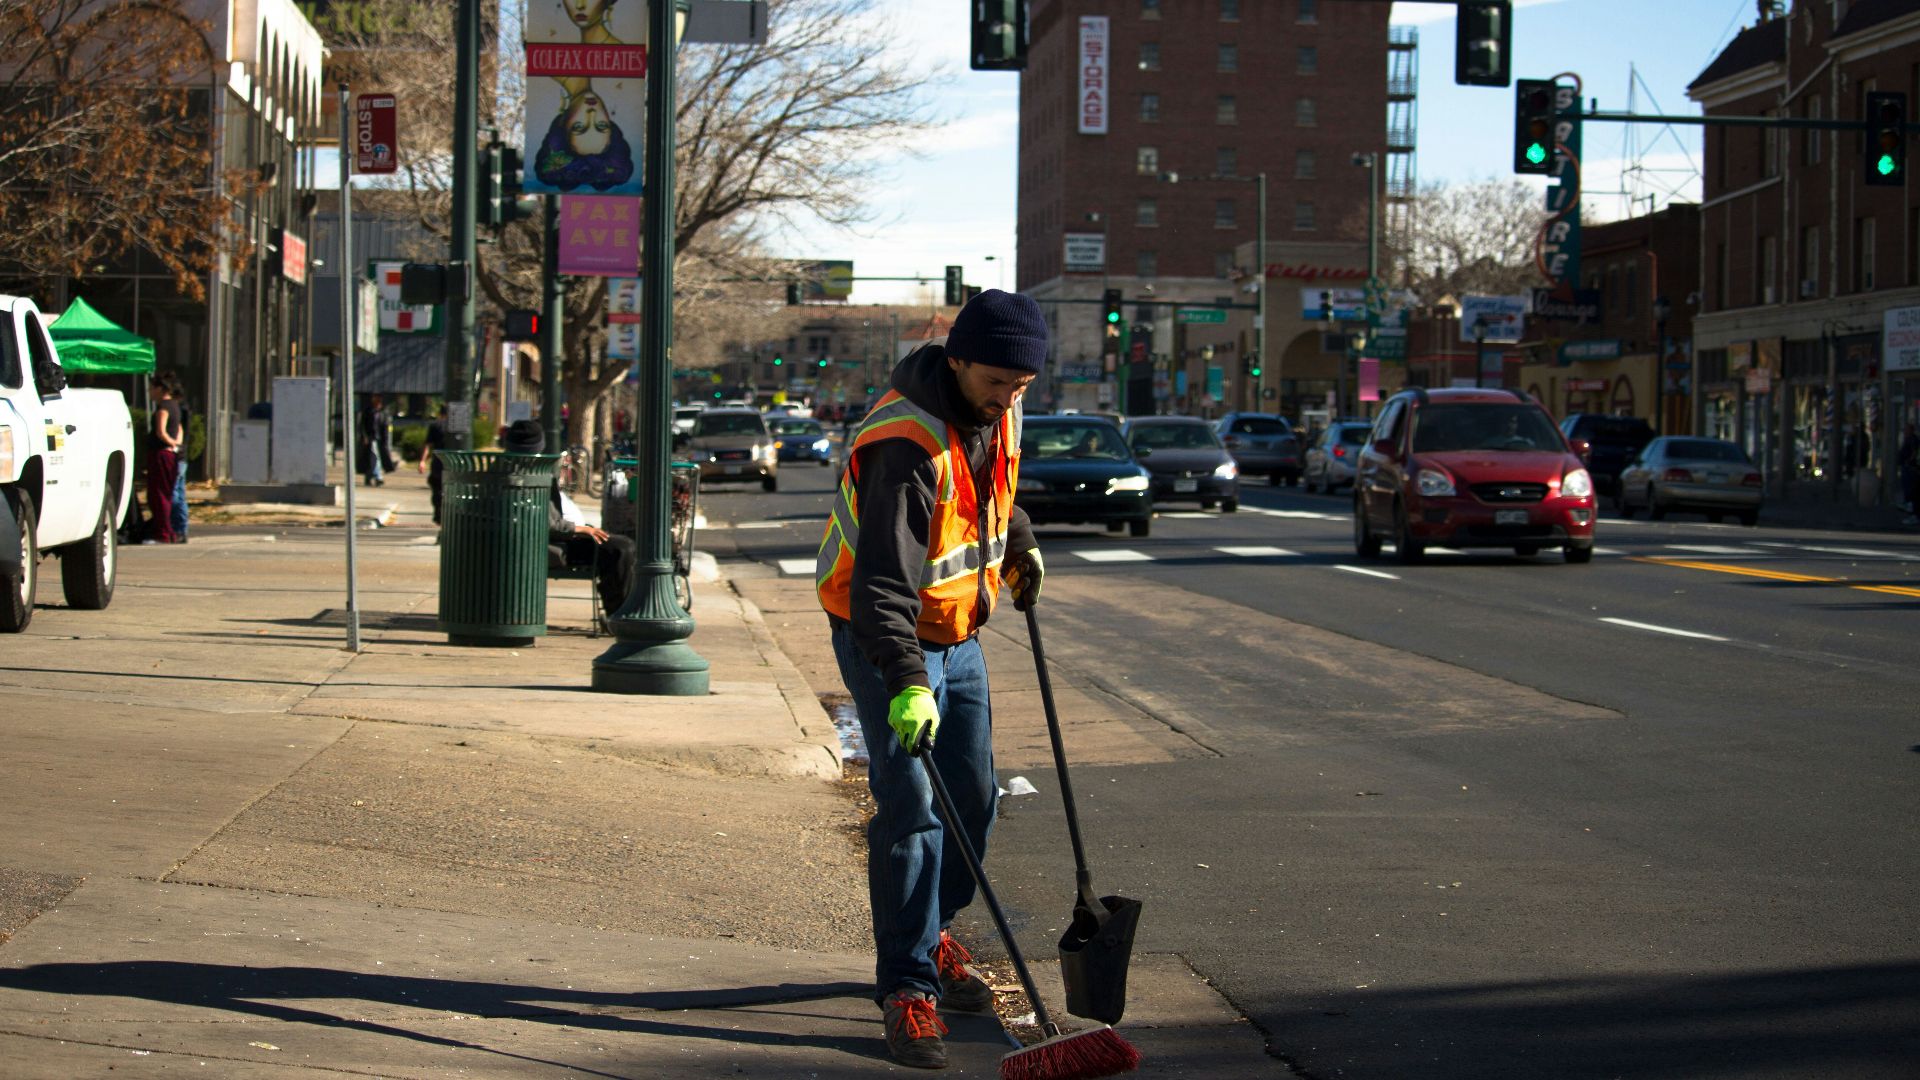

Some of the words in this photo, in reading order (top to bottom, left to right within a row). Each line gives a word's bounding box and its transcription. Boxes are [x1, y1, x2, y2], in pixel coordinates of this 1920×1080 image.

[532, 48, 582, 70] COLFAX
[586, 50, 643, 71] CREATES
[1084, 41, 1103, 127] STORAGE
[359, 111, 373, 153] STOP
[1550, 88, 1574, 275] SATIRE
[570, 202, 629, 221] FAX
[569, 228, 629, 247] AVE
